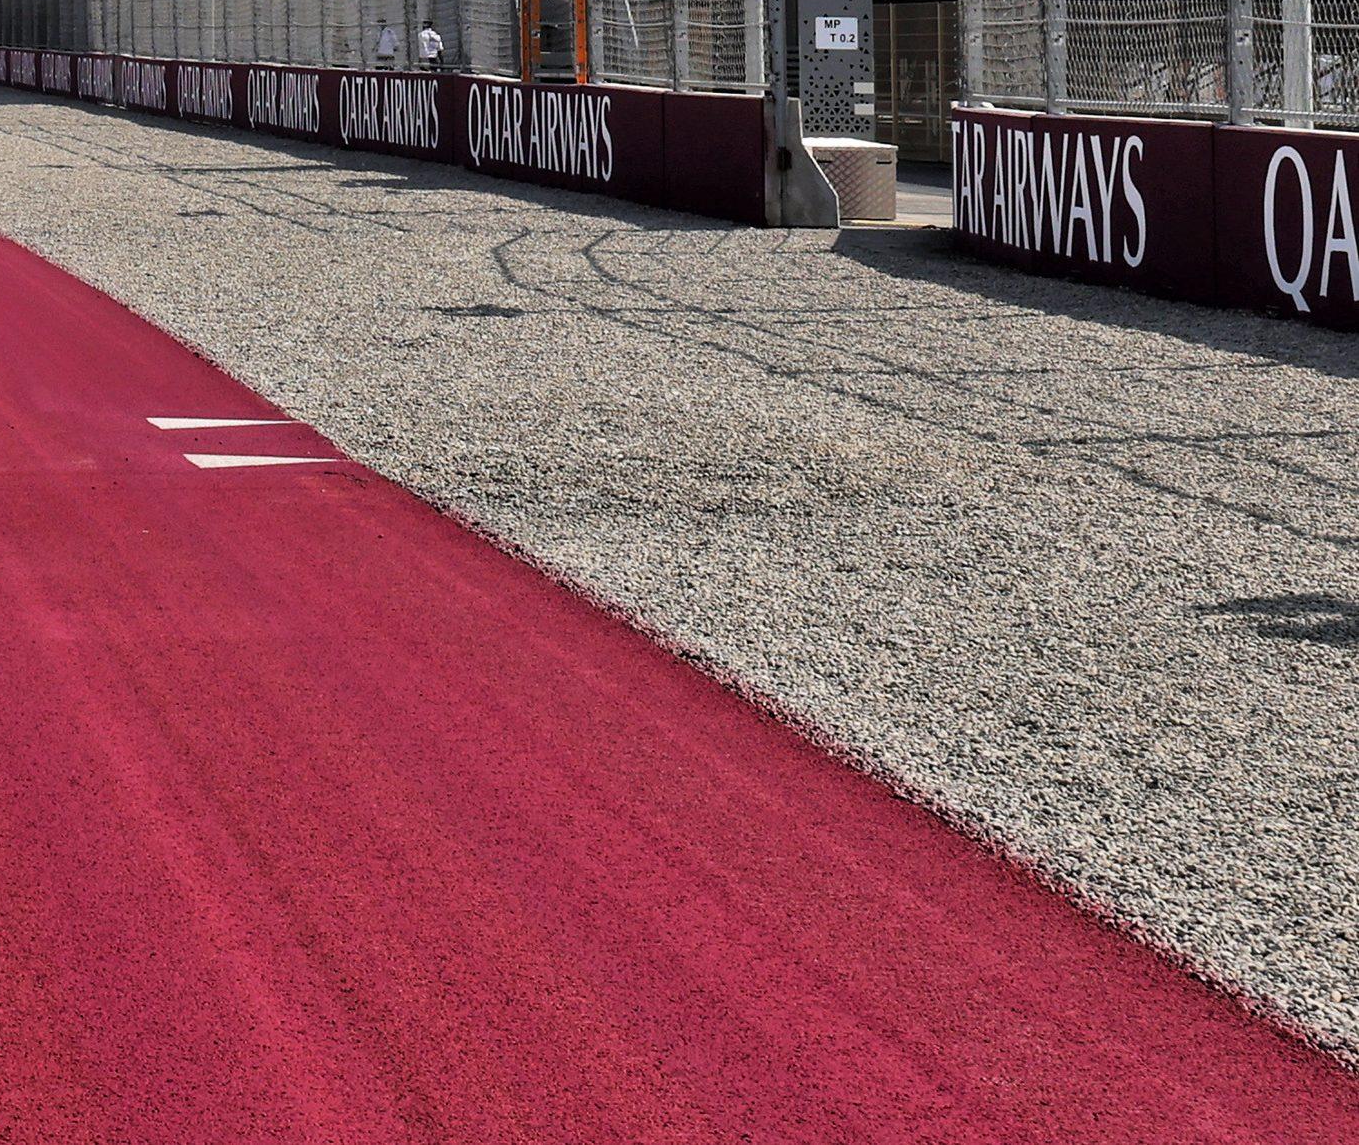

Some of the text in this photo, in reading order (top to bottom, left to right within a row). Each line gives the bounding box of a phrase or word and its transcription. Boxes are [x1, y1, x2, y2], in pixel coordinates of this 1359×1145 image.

[824, 19, 841, 29] MP
[830, 33, 855, 43] T 0.2
[247, 68, 320, 133] QATAR AIRWAYS
[339, 75, 439, 149] QATAR AIRWAYS
[468, 83, 613, 182] QATAR AIRWAYS
[951, 119, 1147, 268] TAR AIRWAYS
